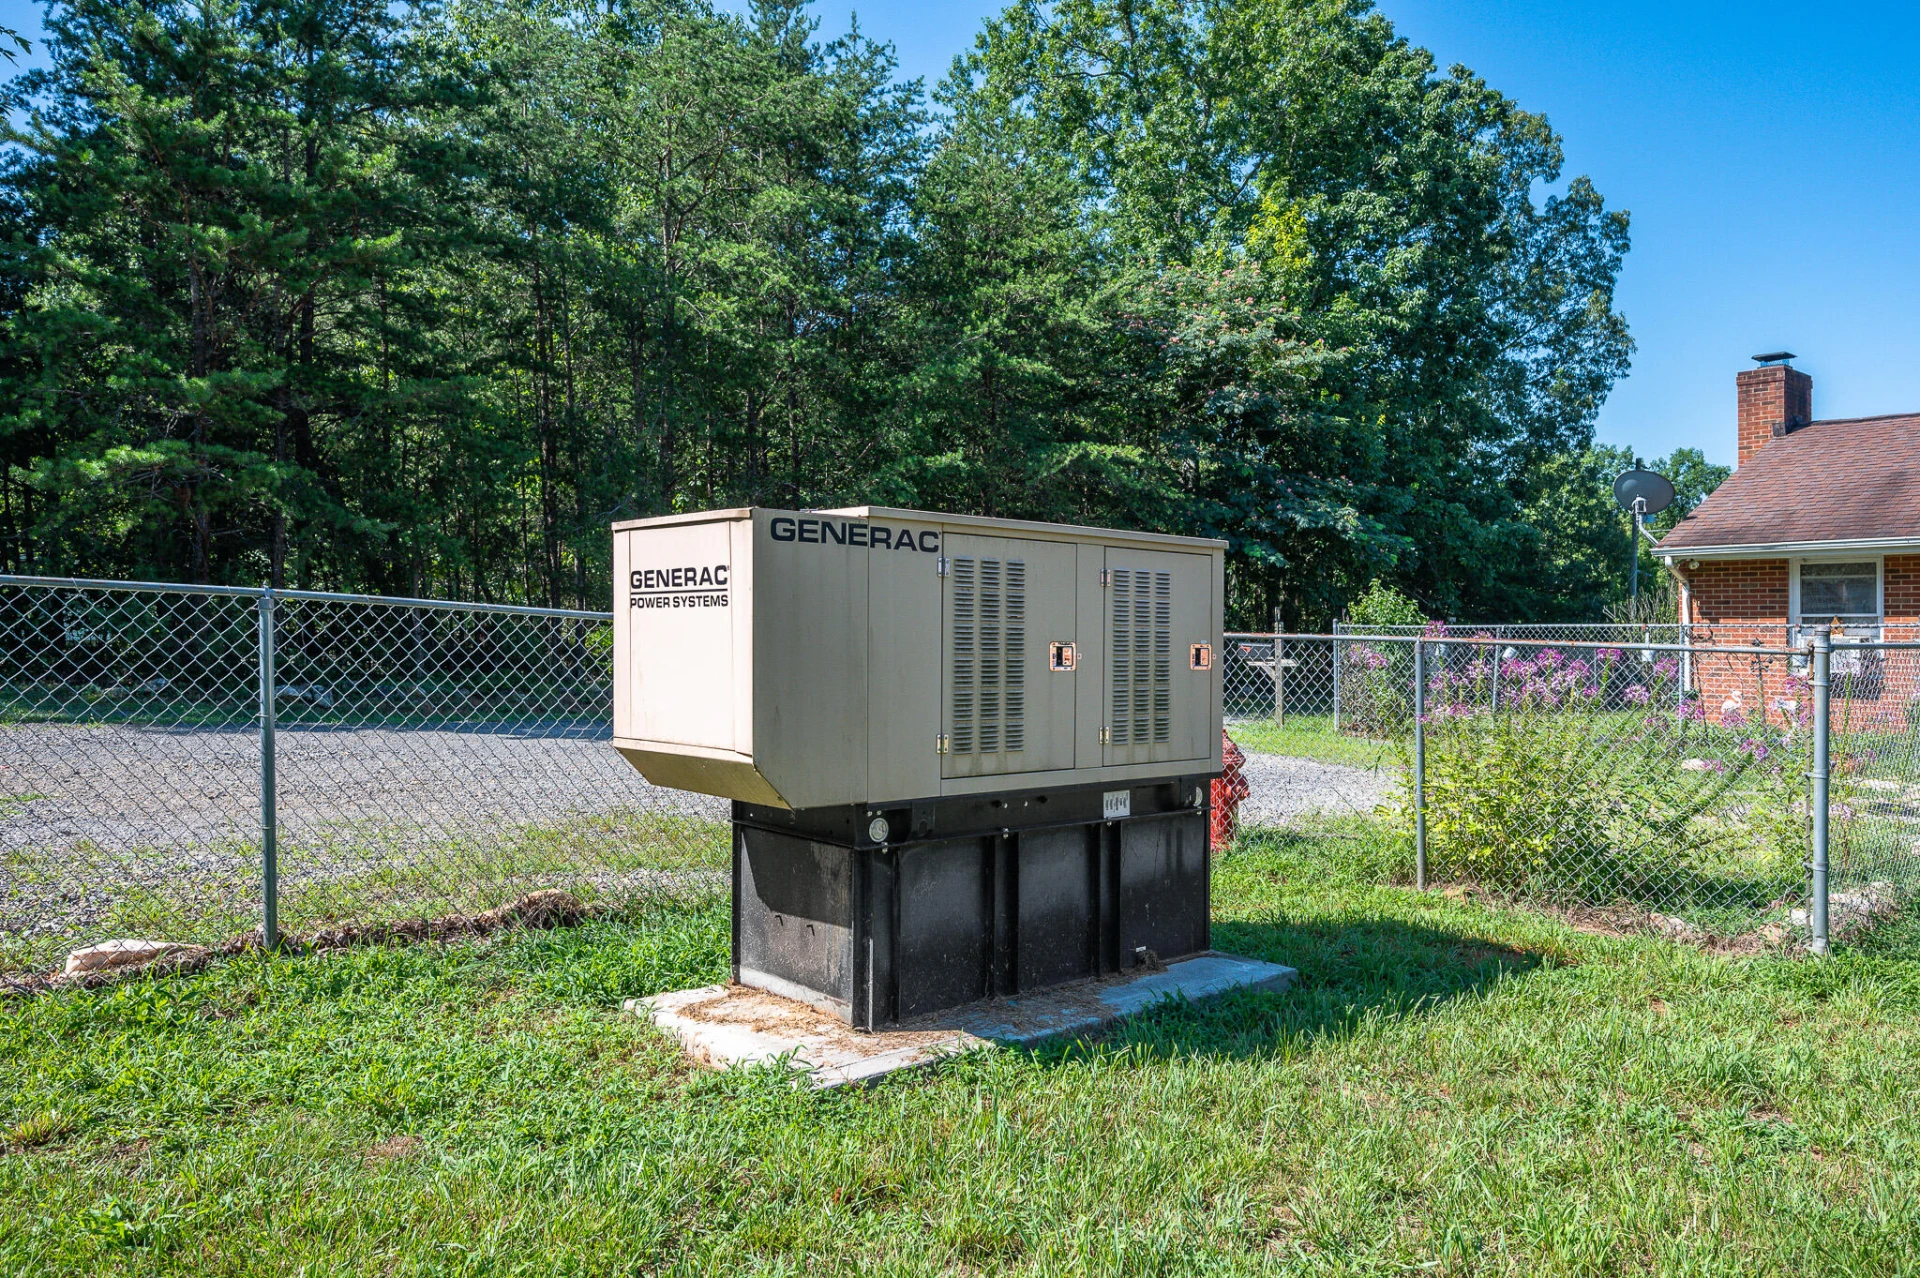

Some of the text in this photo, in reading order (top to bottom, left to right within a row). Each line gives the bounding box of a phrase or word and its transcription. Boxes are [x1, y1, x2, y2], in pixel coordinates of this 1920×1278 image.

[770, 517, 939, 553] GENERAC
[631, 565, 728, 589] GENERAC
[630, 594, 729, 608] POWER SYSTEMS
